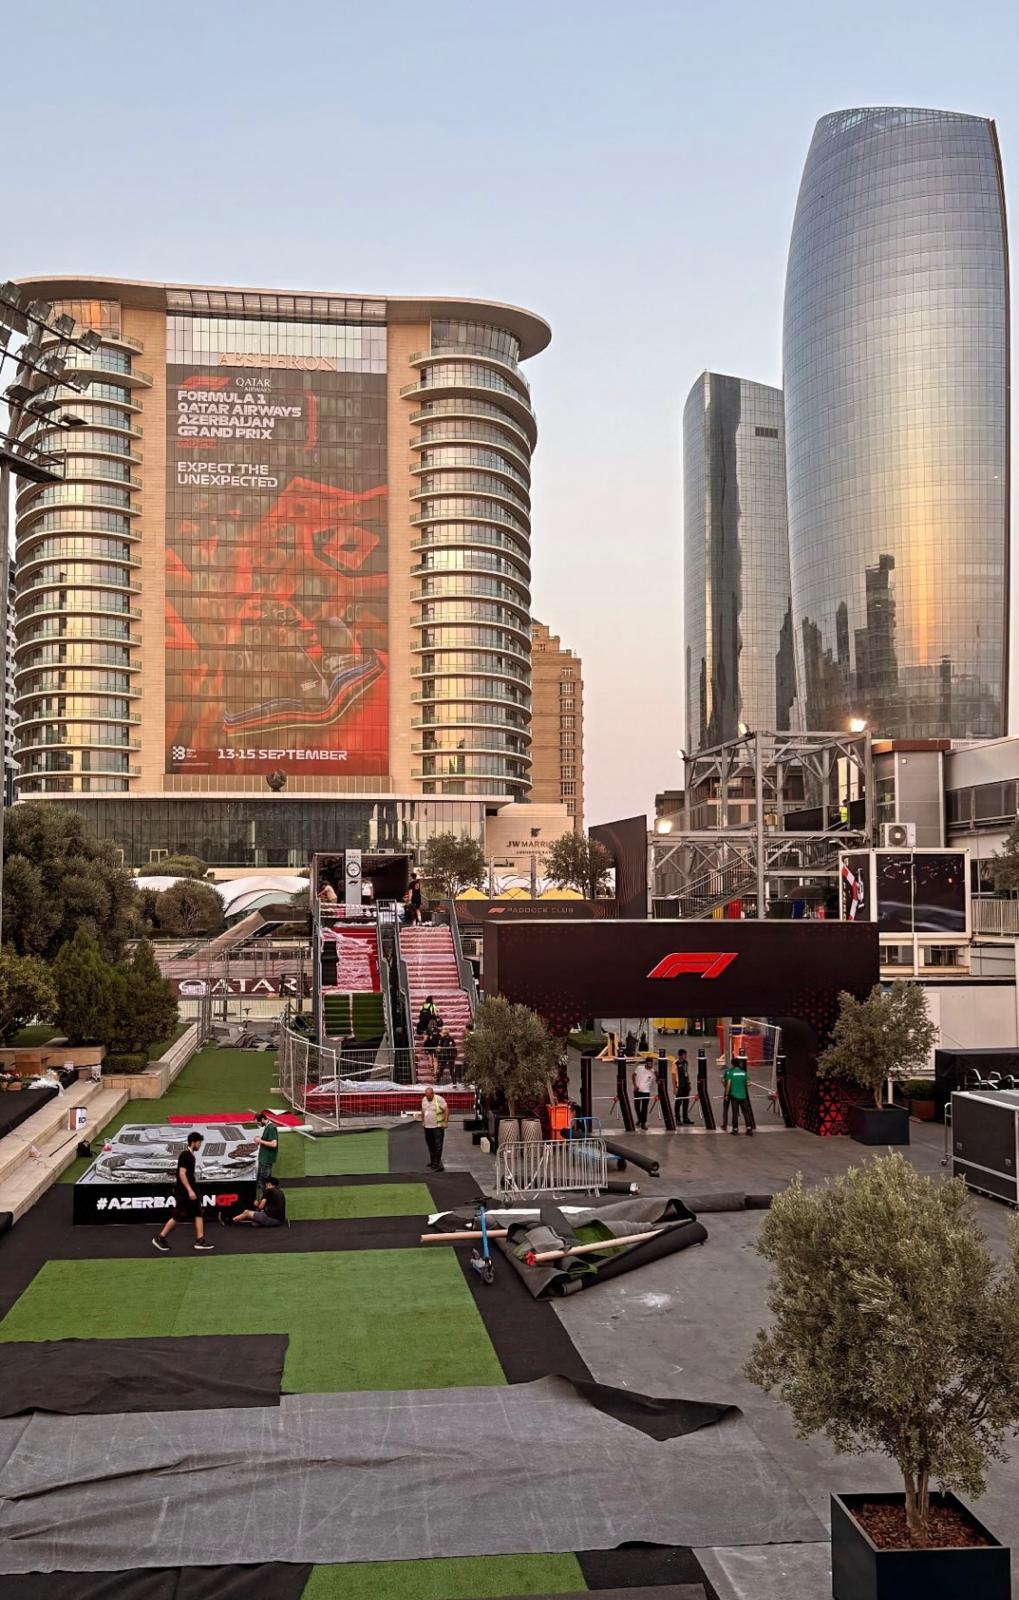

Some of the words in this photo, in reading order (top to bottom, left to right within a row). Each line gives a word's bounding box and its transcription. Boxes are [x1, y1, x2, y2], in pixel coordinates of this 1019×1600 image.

[219, 353, 337, 372] ABSHERON
[235, 377, 272, 388] QATAR
[244, 386, 272, 394] AIRWAYS
[177, 390, 255, 404] FORMULA
[257, 393, 267, 405] 1
[177, 402, 230, 415] QATAR
[232, 404, 302, 418] AIRWAYS
[177, 414, 275, 428] AZERBAIJAN
[177, 426, 233, 438] GRAND
[235, 428, 272, 440] PRIX
[177, 461, 235, 474] EXPECT
[237, 463, 269, 475] THE
[177, 474, 278, 488] UNEXPECTED
[258, 749, 348, 761] SEPTEMBER
[521, 840, 556, 848] MARRIO
[96, 1193, 239, 1211] #AZERBANGP
